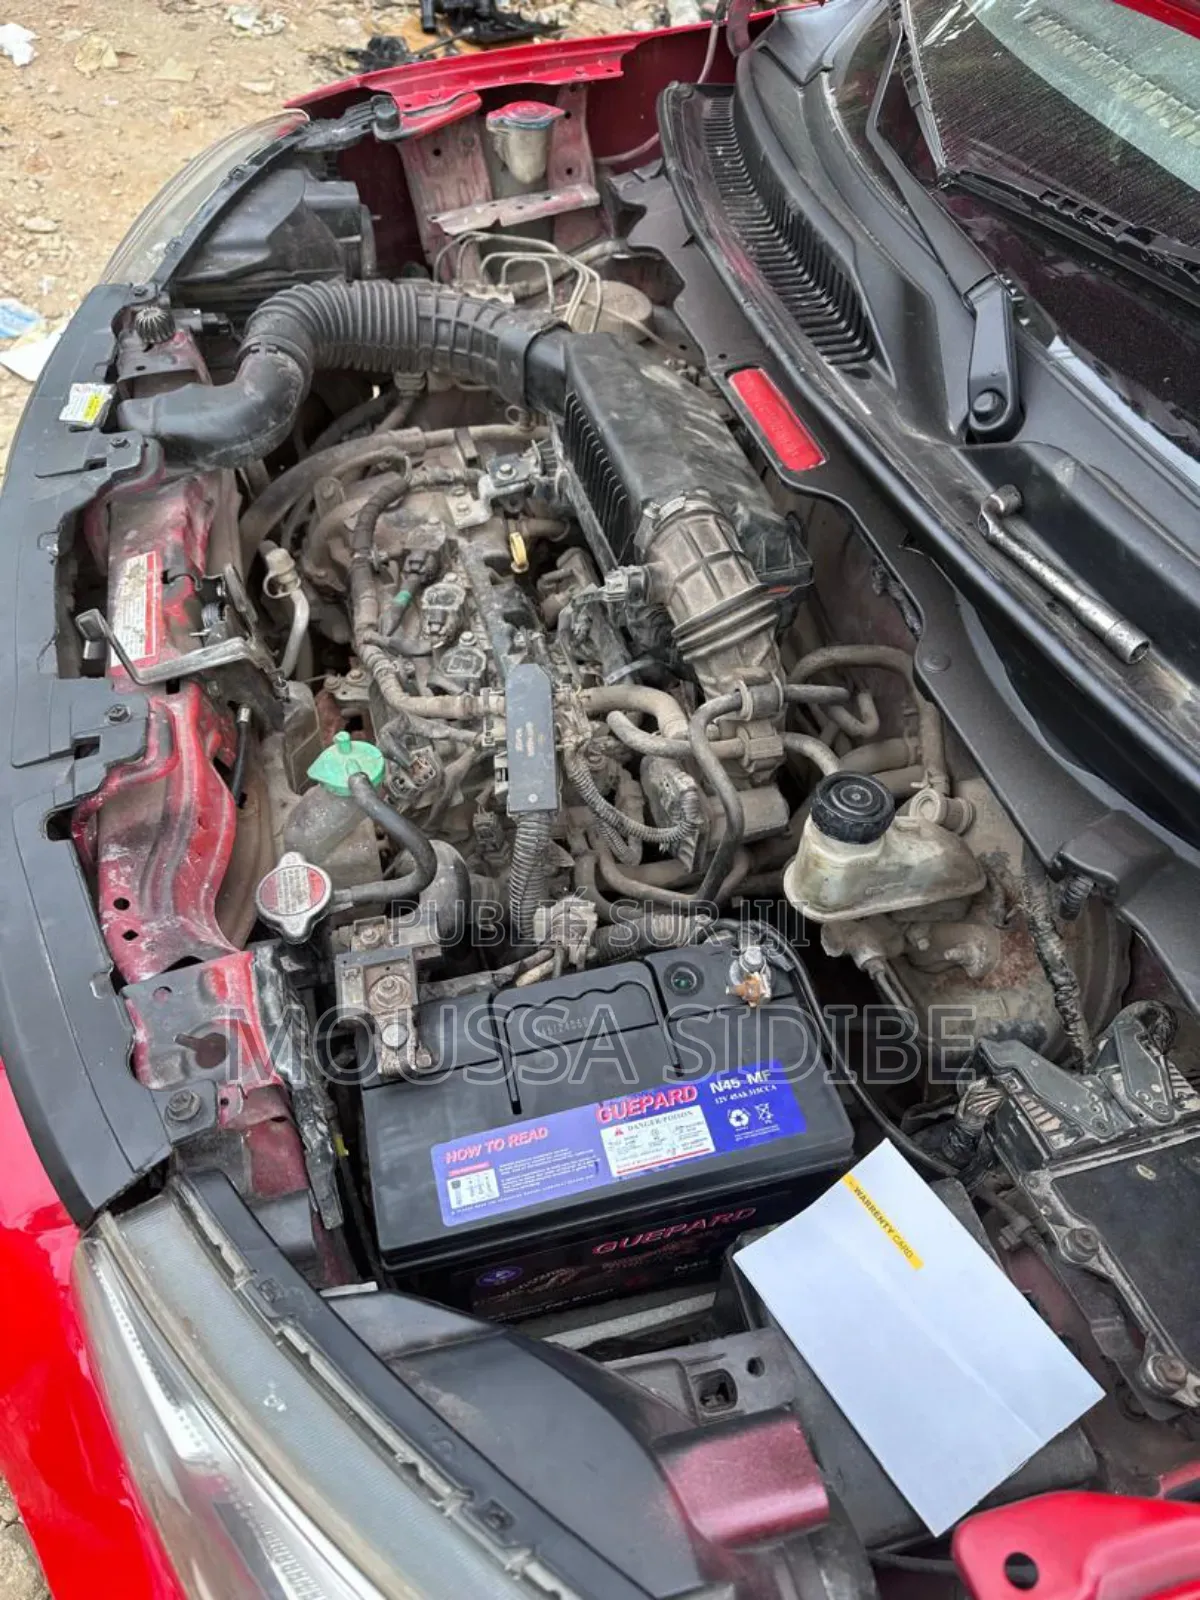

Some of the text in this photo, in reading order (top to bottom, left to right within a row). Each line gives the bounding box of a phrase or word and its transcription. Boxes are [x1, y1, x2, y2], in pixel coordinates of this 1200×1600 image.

[709, 1069, 772, 1094] N45 MF
[596, 1086, 698, 1123] GUEPARD
[445, 1126, 549, 1165] HOW TO READ
[592, 1207, 757, 1255] GUEPARD
